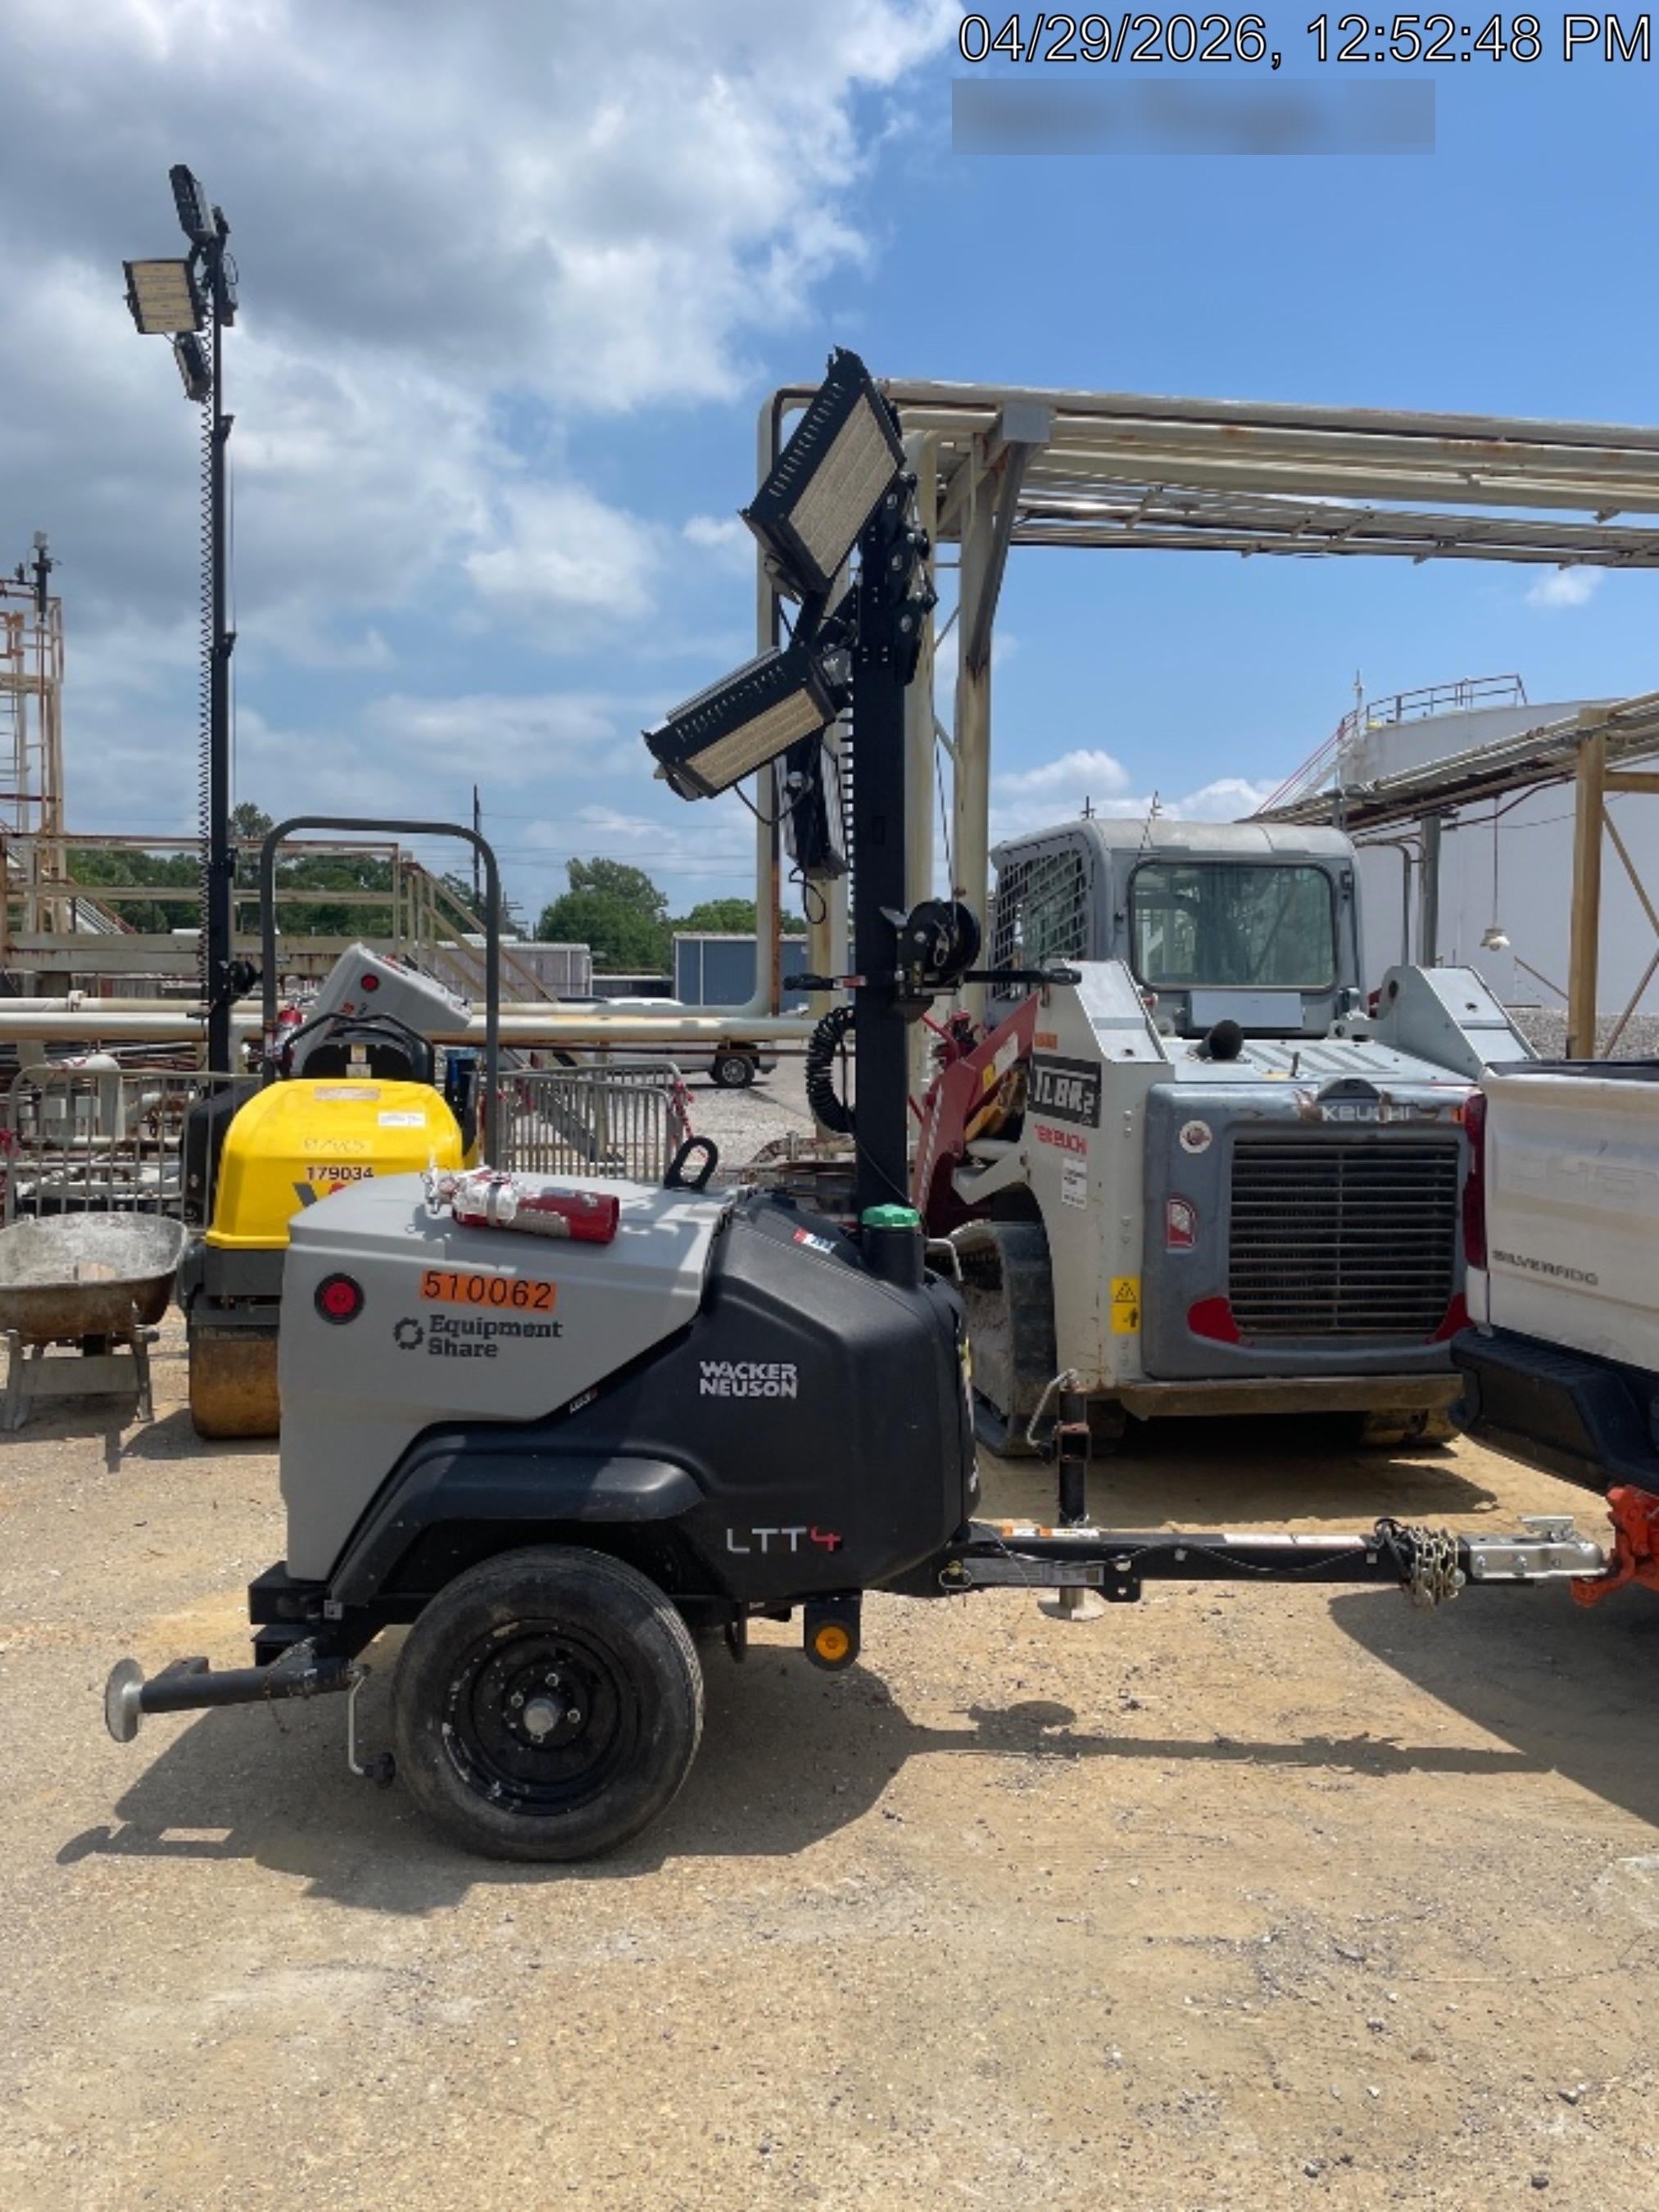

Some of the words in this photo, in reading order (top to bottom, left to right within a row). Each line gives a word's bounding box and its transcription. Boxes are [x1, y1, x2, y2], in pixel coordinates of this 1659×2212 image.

[306, 1166, 374, 1181] 179034
[424, 1271, 551, 1308] 510062
[429, 1314, 564, 1339] Equipment
[428, 1337, 498, 1358] Share
[699, 1361, 798, 1380] WACKER
[699, 1378, 798, 1398] NEUSON
